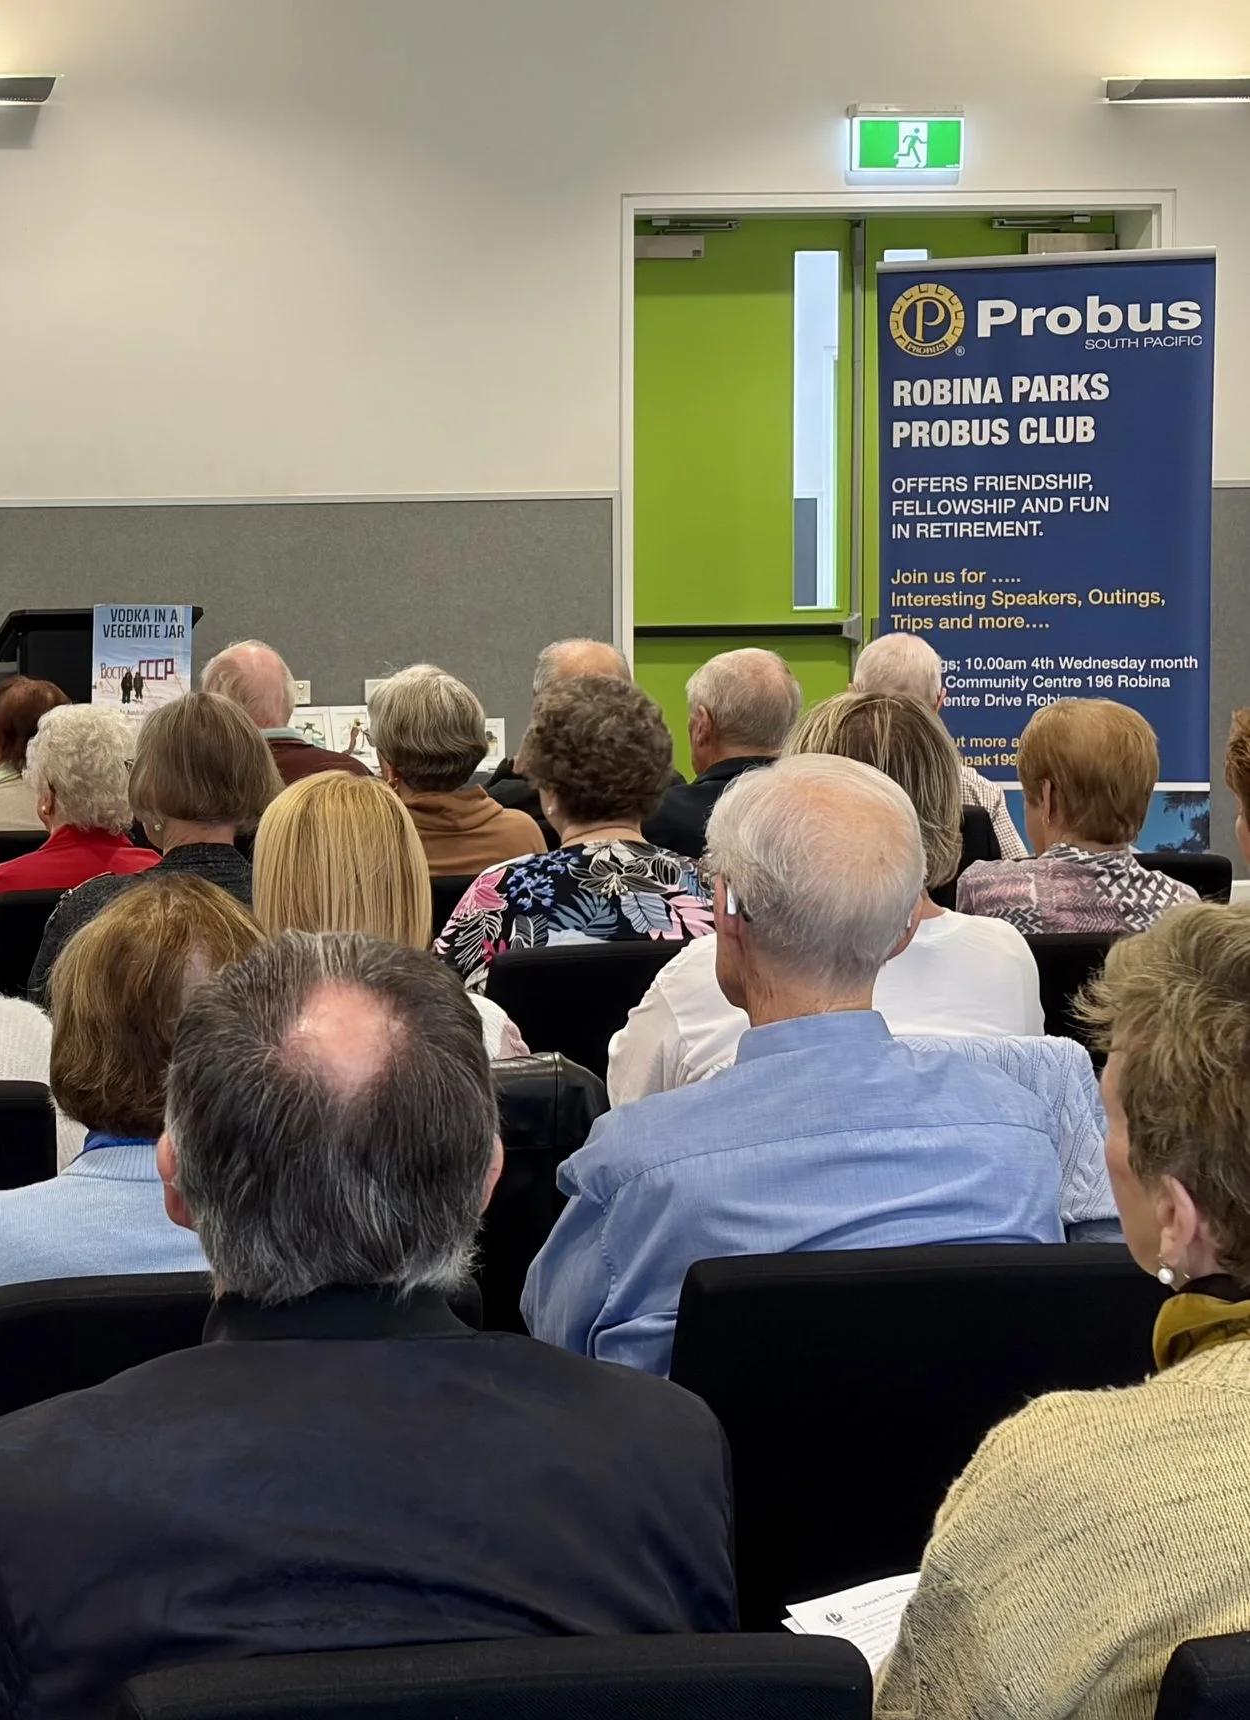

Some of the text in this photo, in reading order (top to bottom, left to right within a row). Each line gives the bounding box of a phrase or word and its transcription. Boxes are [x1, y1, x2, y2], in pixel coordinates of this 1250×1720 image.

[914, 298, 946, 342] P
[977, 295, 1202, 338] Probus
[1085, 335, 1203, 350] SOUTH PACIFIC
[892, 373, 1110, 407] ROBINA PARKS
[892, 415, 1096, 448] PROBUS CLUB
[891, 473, 1094, 494] OFFERS FRIENDSHIP,
[891, 496, 1110, 517] FELLOWSHIP AND FUN
[891, 520, 1044, 539] IN RETIREMENT.
[891, 569, 928, 585] Join
[934, 571, 956, 584] us
[960, 568, 986, 583] for
[891, 588, 1166, 609] Interesting Speakers, Outings,
[110, 608, 178, 623] VODKA IN A
[890, 614, 934, 633] Trips
[938, 614, 973, 630] and
[103, 624, 185, 639] VEGEMITE JAR
[964, 657, 1027, 670] 10.00am
[1031, 657, 1054, 670] 4th
[1059, 656, 1146, 673] Wednesday
[1150, 656, 1198, 670] month
[945, 675, 1170, 691] Community Centre 196 Robina
[943, 694, 980, 706] entre
[984, 693, 1022, 707] Drive
[970, 737, 1007, 748] more
